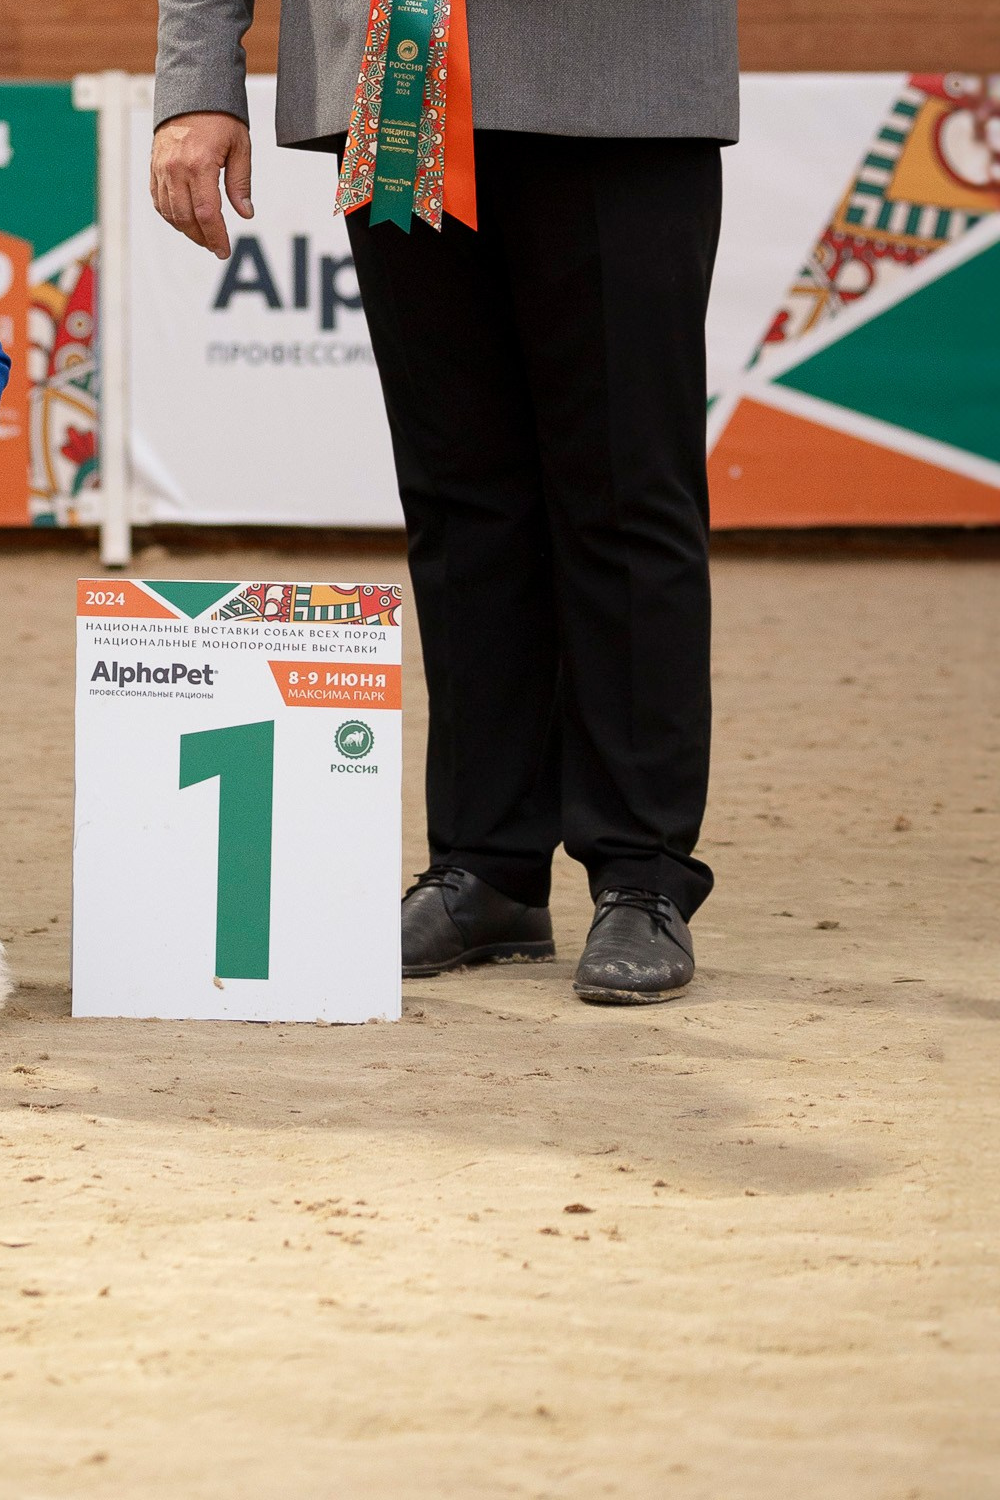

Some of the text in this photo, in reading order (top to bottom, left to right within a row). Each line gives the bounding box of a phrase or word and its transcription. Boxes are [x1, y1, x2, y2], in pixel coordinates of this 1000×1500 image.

[410, 7, 428, 15] ПОРОД
[389, 61, 423, 72] РОССИЯ
[396, 80, 411, 88] РКФ
[381, 127, 416, 138] ПОБЕДИТЕЛЬ
[386, 136, 409, 145] КЛАССА
[399, 178, 411, 187] Парк
[85, 591, 126, 606] 2024
[85, 622, 387, 641] НАЦИОНАЛЬНЫЕ ВЫСТАВКИ СОБАК ВСЕХ ПОРОД
[94, 637, 377, 653] НАЦИОНАЛЬНЫЕ МОНОПОРОДНЫЕ ВЫСТАВКИ
[90, 660, 214, 688] AlphaPet
[288, 671, 386, 688] 8-9 ИЮНЯ
[89, 688, 214, 699] ПРОФЕССИОНАЛЬНЫЕ РАЦИОНЫ
[287, 689, 385, 701] МАКСИМА ПАРК
[330, 763, 378, 774] РОССИЯ
[179, 719, 275, 980] 1
